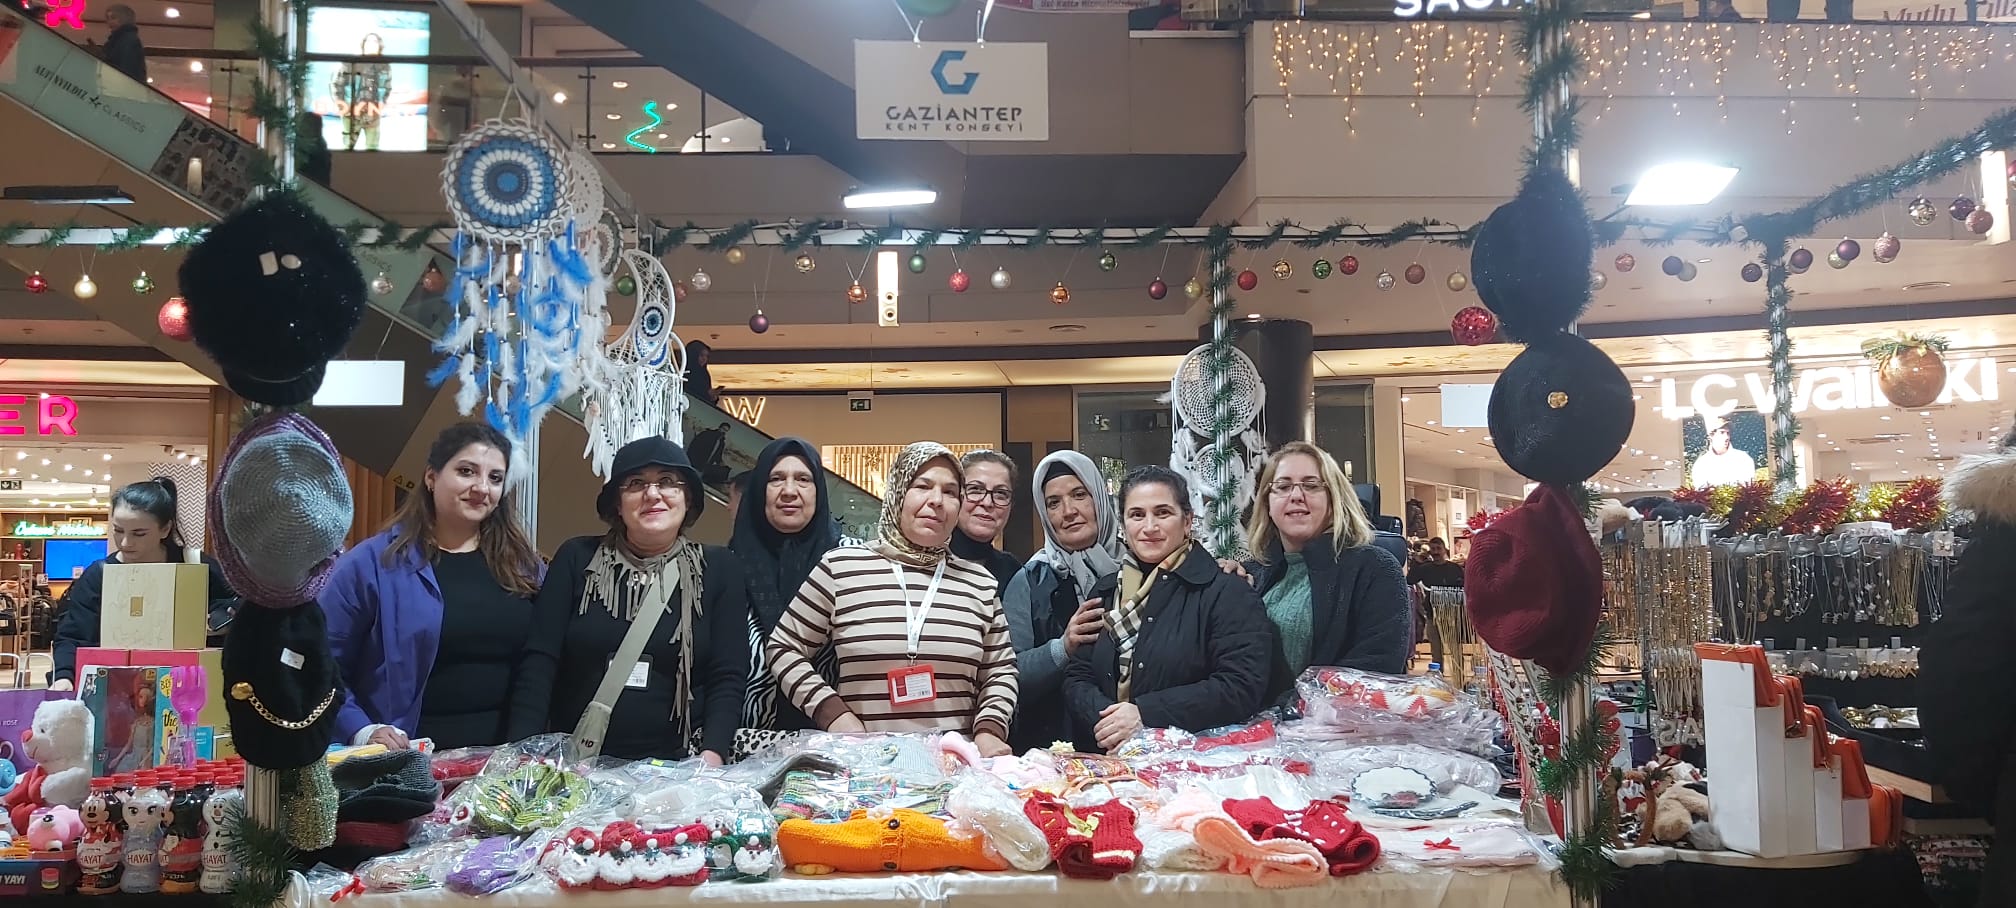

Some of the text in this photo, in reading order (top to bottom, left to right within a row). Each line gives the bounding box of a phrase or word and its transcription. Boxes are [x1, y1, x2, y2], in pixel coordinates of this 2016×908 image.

[886, 104, 1022, 121] GAZİANTEP
[886, 123, 930, 131] KENT
[1660, 373, 1738, 420] LC
[80, 854, 103, 865] HAYAT
[127, 853, 153, 866] HAYAT
[203, 854, 228, 865] HAYAT
